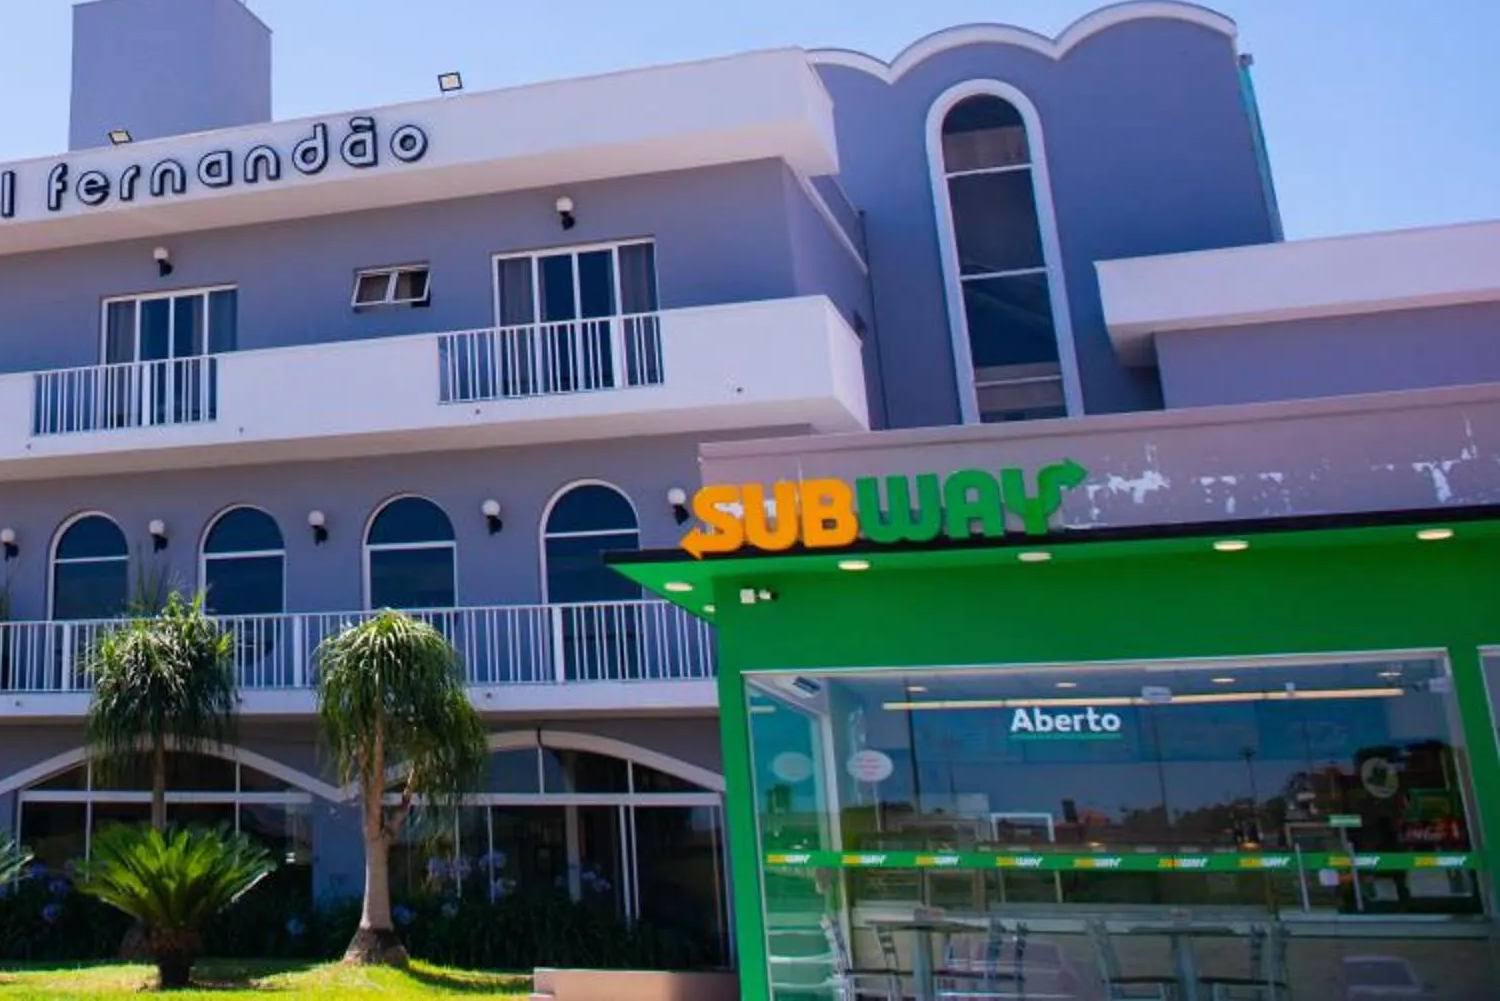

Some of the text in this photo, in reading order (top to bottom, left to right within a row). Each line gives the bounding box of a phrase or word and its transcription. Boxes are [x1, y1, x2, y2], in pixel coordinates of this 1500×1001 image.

[47, 116, 428, 210] fernandão
[679, 458, 1089, 560] SUBWAY
[1010, 707, 1121, 732] Aberto
